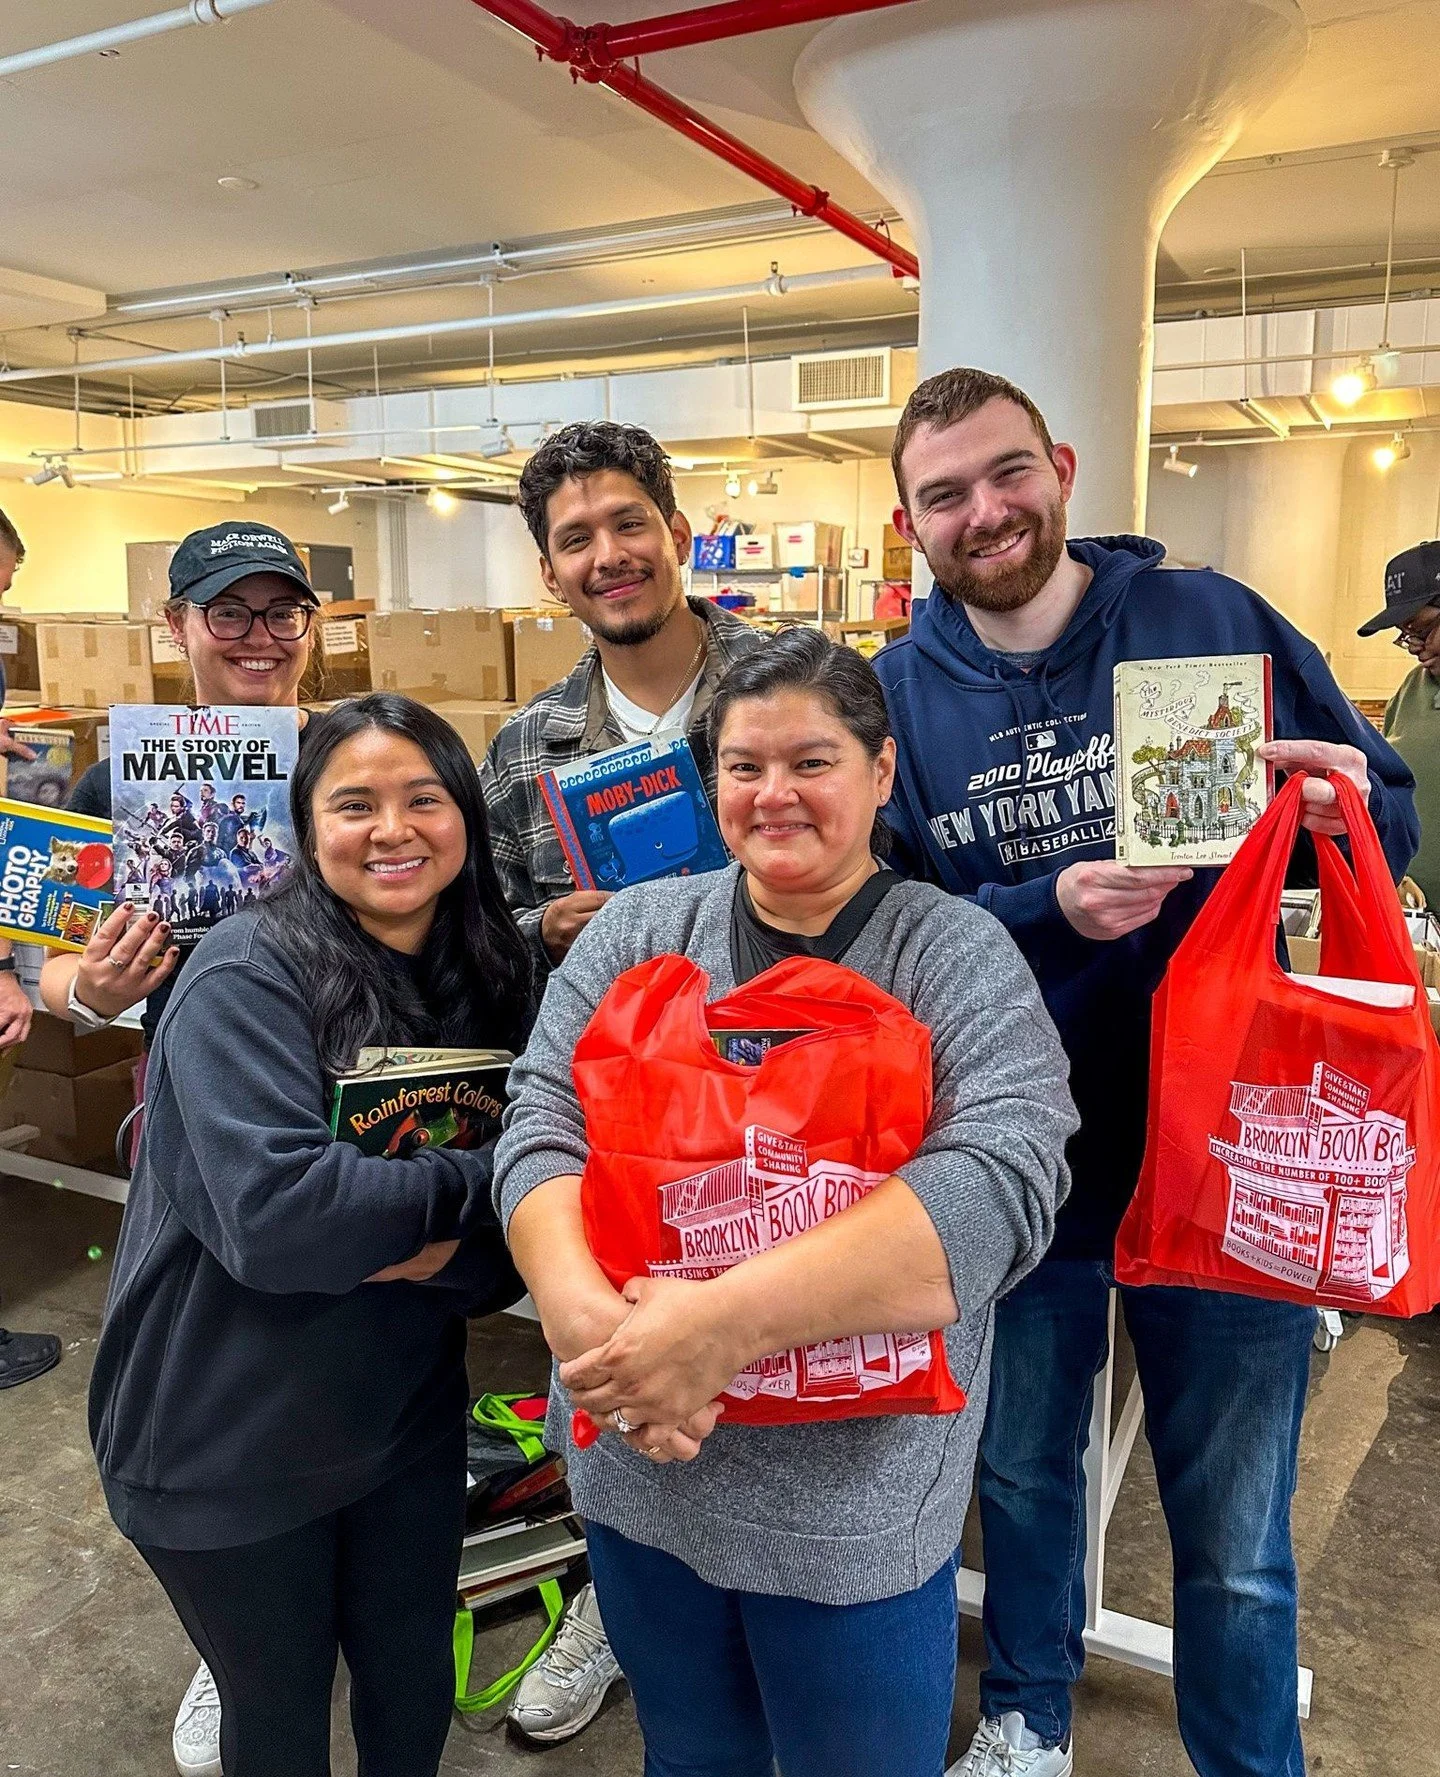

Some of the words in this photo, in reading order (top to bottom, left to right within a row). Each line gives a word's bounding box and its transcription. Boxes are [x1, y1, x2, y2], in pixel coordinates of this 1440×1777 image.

[210, 540, 255, 555] FICTION
[257, 541, 289, 555] AGAIN
[242, 534, 285, 547] ORWELL
[169, 714, 240, 736] TIME
[989, 731, 1004, 743] MLB
[1005, 721, 1043, 737] AUTENTIC
[1046, 712, 1088, 727] COLECTION
[1167, 716, 1210, 738] BENEDICT
[1214, 723, 1255, 738] SOCIETY
[141, 739, 176, 753] THE
[181, 739, 243, 753] STORY
[246, 739, 271, 753] OF
[122, 753, 288, 781] MARVEL
[967, 763, 1021, 791] 2010
[585, 765, 682, 818] MOBY-DICK
[926, 807, 976, 850] NEW
[978, 788, 1062, 838] YORK
[1019, 826, 1100, 857] BASEBALL
[0, 845, 32, 925] PHOTO
[17, 849, 49, 928] GRAPHY
[170, 927, 184, 935] rom
[185, 926, 209, 934] humble
[1323, 1081, 1366, 1108] COMMUNITY
[1324, 1069, 1369, 1100] GIVE&TAKE
[349, 1081, 452, 1137] Rainforest
[453, 1080, 503, 1119] Colors
[1326, 1093, 1361, 1116] SHARING
[757, 1132, 804, 1153] GIVE&TAKE
[757, 1145, 804, 1165] COMMUNITY
[1243, 1126, 1310, 1160] BROOKLYN
[1319, 1124, 1374, 1163] BOOK
[763, 1158, 801, 1174] SHARING
[1211, 1143, 1258, 1171] INCREASING
[1259, 1160, 1276, 1174] THE
[1278, 1165, 1316, 1182] NUMBER
[1318, 1170, 1330, 1182] OF
[1334, 1173, 1361, 1186] 100+
[684, 1215, 760, 1259] BROOKLYN
[768, 1178, 819, 1242] BOOK
